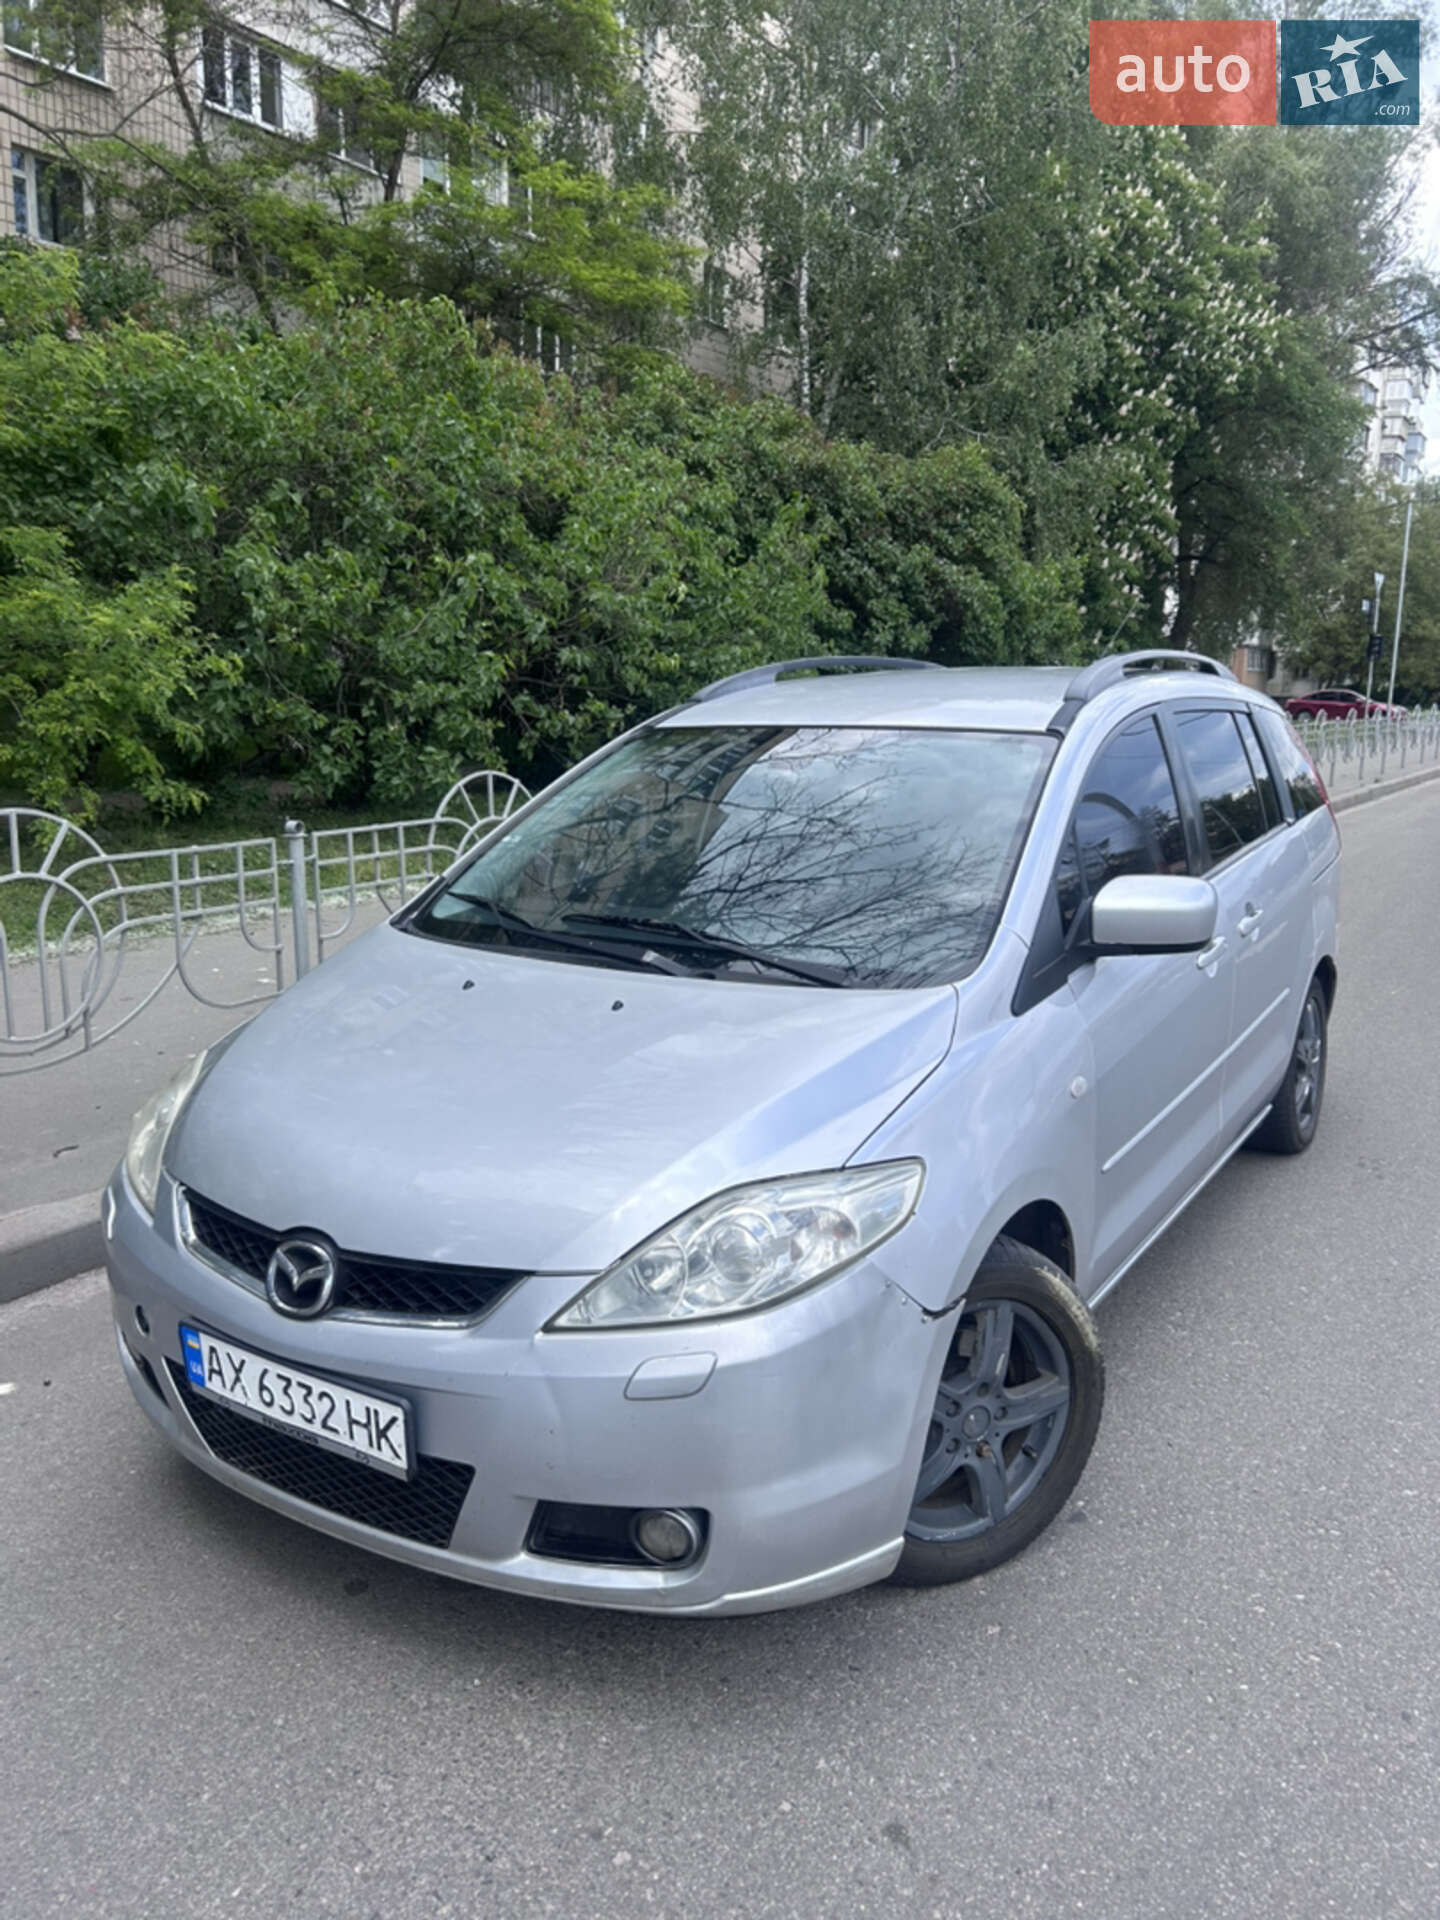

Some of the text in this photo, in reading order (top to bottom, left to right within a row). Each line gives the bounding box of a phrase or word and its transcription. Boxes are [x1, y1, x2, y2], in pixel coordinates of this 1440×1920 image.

[207, 1345, 250, 1399] AX
[258, 1367, 340, 1435] 6332
[345, 1398, 402, 1461] HK
